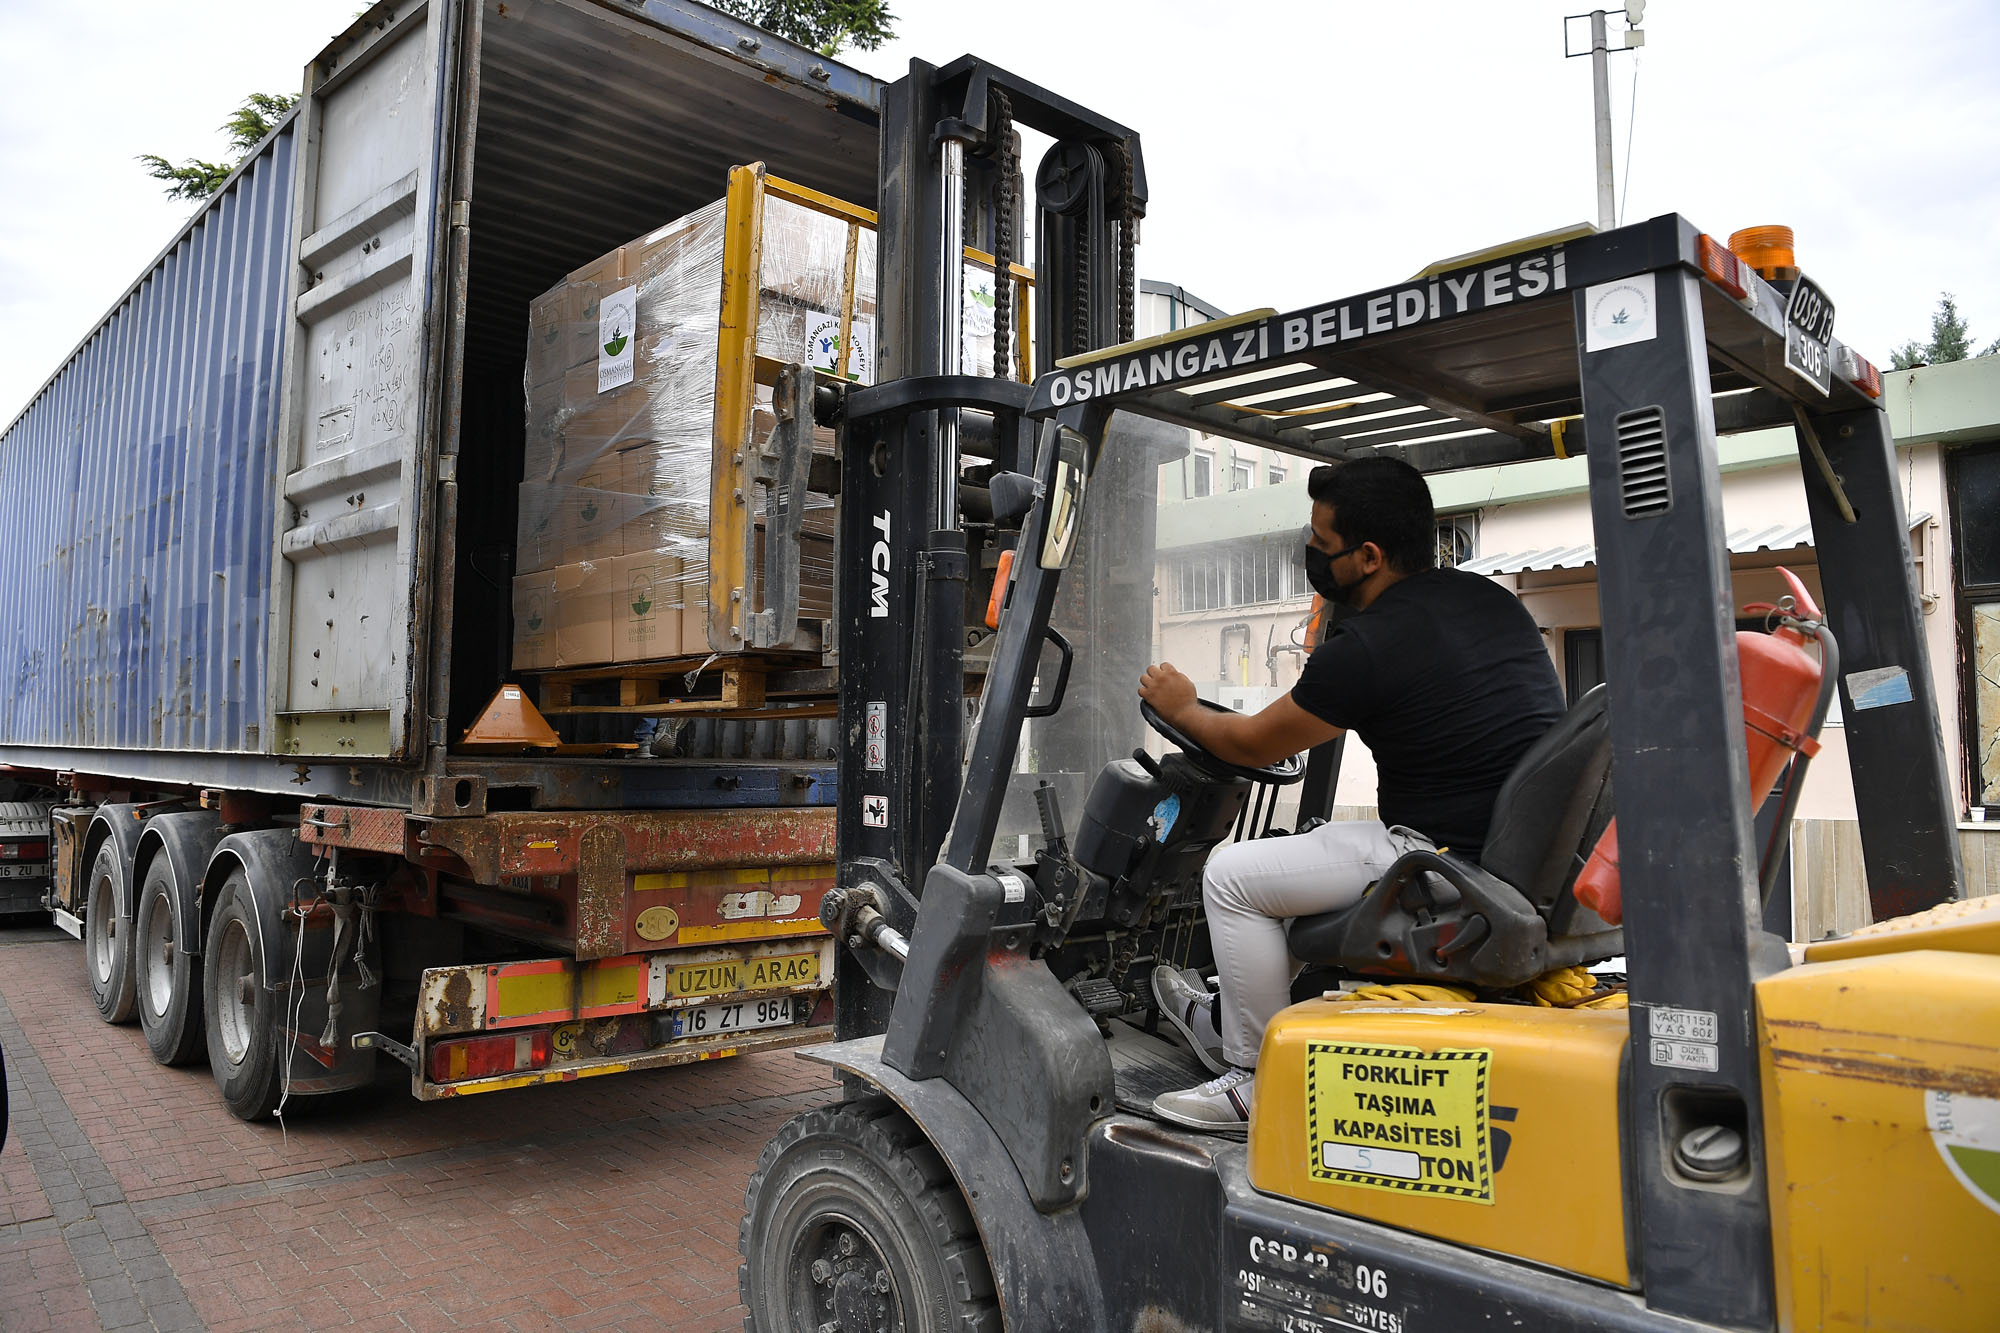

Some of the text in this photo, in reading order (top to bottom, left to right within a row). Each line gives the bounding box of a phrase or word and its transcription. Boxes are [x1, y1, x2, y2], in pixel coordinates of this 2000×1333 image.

[1050, 320, 1268, 407] OSMANGAZİ
[1283, 243, 1567, 354] BELEDİYESİ
[1794, 286, 1834, 344] OSB 13
[1800, 334, 1822, 378] 306
[871, 509, 891, 617] TCM
[18, 865, 32, 876] ZU
[678, 958, 809, 993] UZUN ARAÇ
[687, 999, 790, 1033] 16 ZT 964
[1342, 1064, 1449, 1087] FORKLİFT
[1354, 1092, 1437, 1117] TAŞIMA
[1333, 1118, 1462, 1149] KAPASİTESİ
[1354, 1149, 1475, 1182] 5 TON
